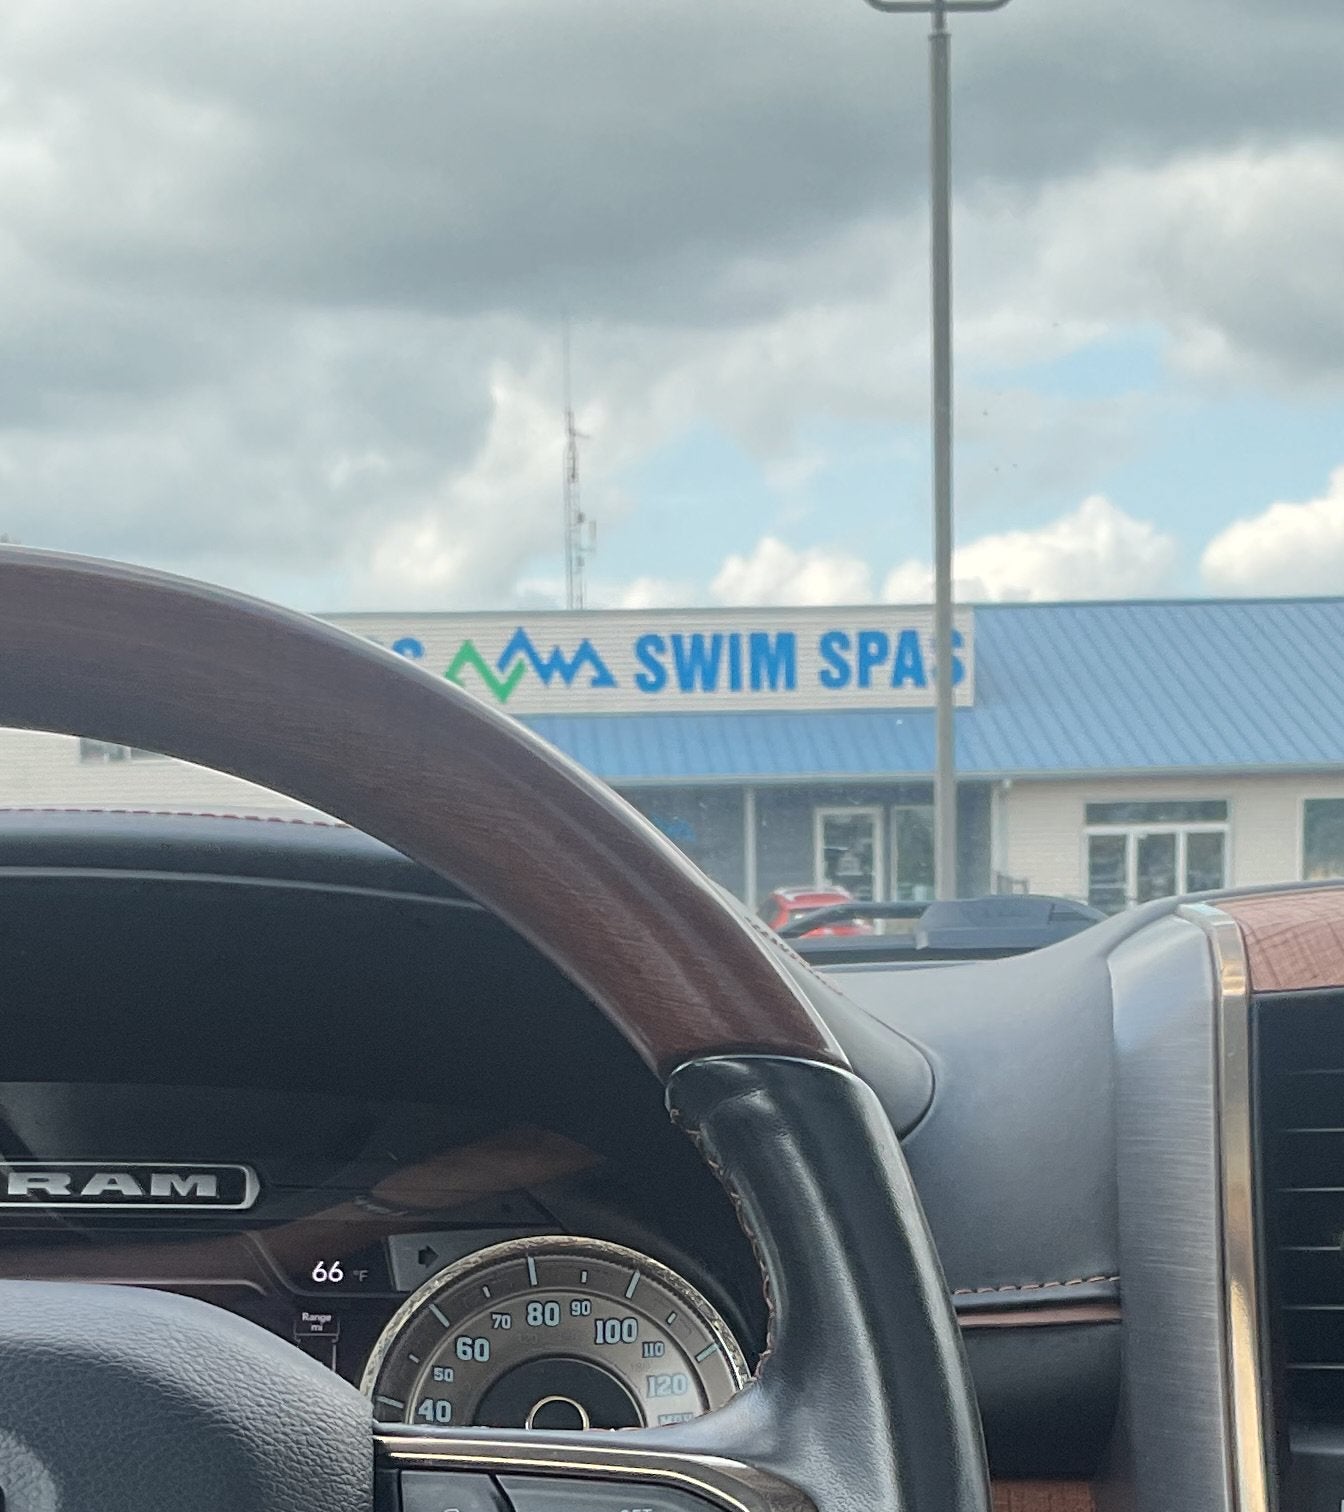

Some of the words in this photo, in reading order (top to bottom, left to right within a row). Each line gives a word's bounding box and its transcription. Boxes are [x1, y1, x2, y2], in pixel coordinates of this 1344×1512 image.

[635, 633, 796, 692] SWIM
[8, 1172, 216, 1196] RAM
[312, 1261, 343, 1282] 66
[302, 1312, 331, 1324] Range
[525, 1300, 561, 1327] 80
[569, 1299, 592, 1317] 90
[490, 1312, 512, 1330] 70
[594, 1317, 638, 1345] 100
[456, 1337, 490, 1361] 60
[642, 1341, 665, 1358] 110
[433, 1365, 454, 1382] 50
[646, 1373, 688, 1398] 120
[419, 1399, 452, 1422] 40
